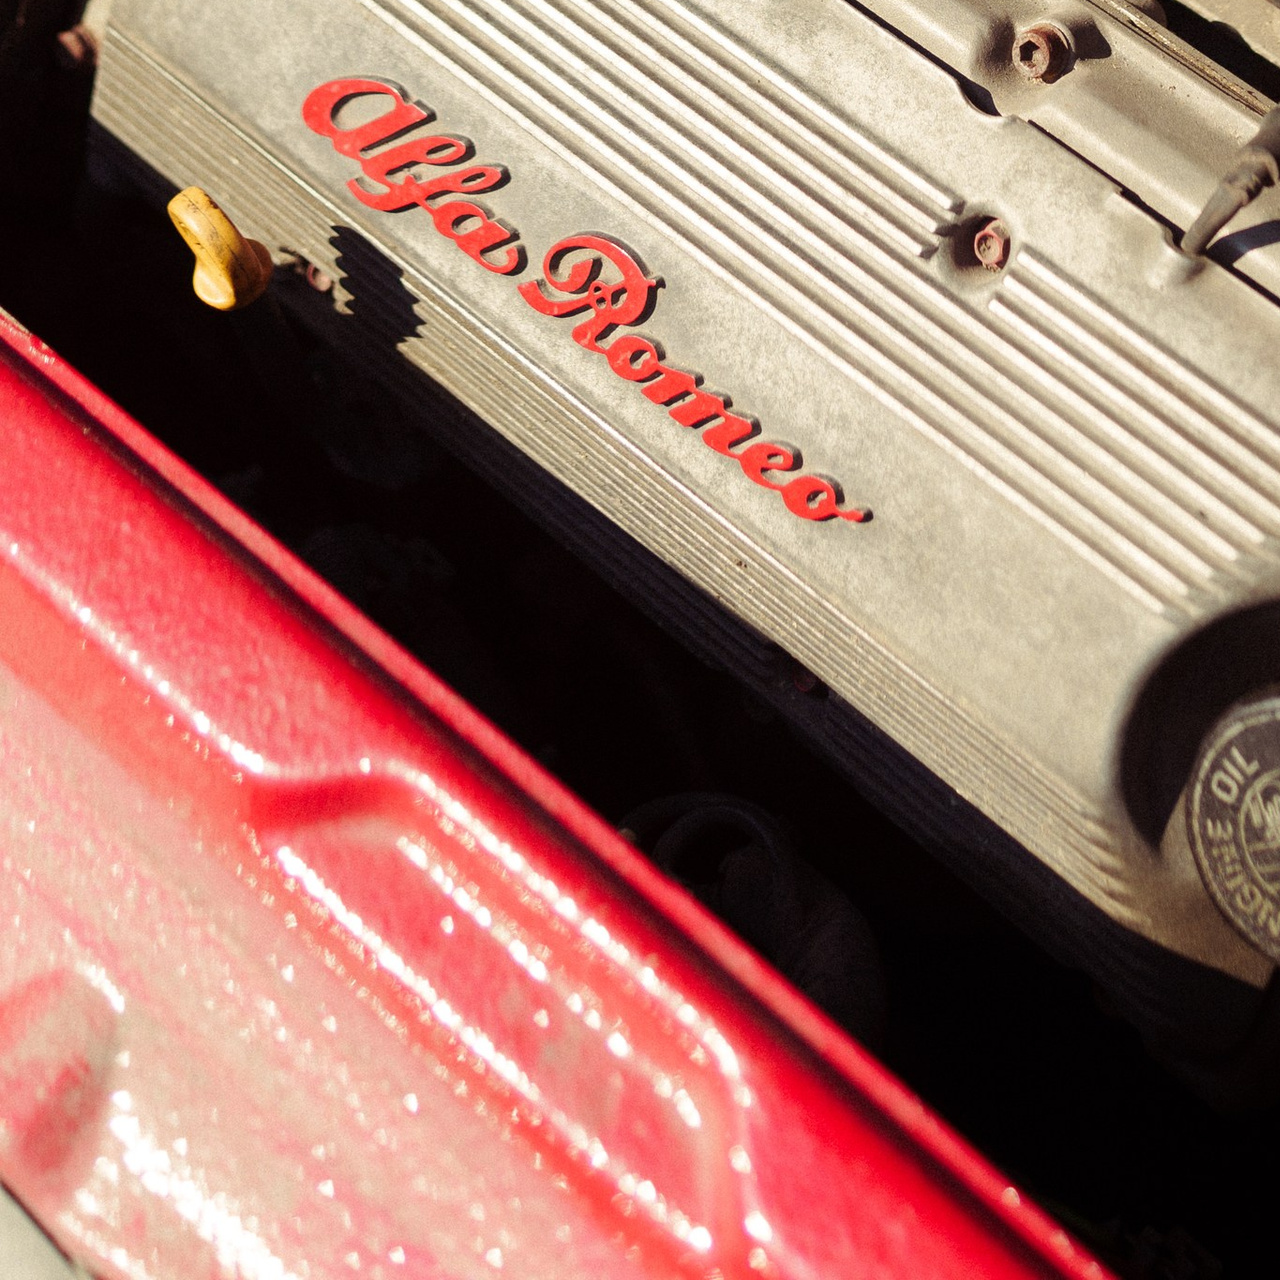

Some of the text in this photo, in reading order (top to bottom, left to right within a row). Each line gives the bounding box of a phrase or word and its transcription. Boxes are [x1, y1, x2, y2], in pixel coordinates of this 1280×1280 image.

[302, 77, 868, 524] Alfa Romeo
[1211, 745, 1261, 805] OIL
